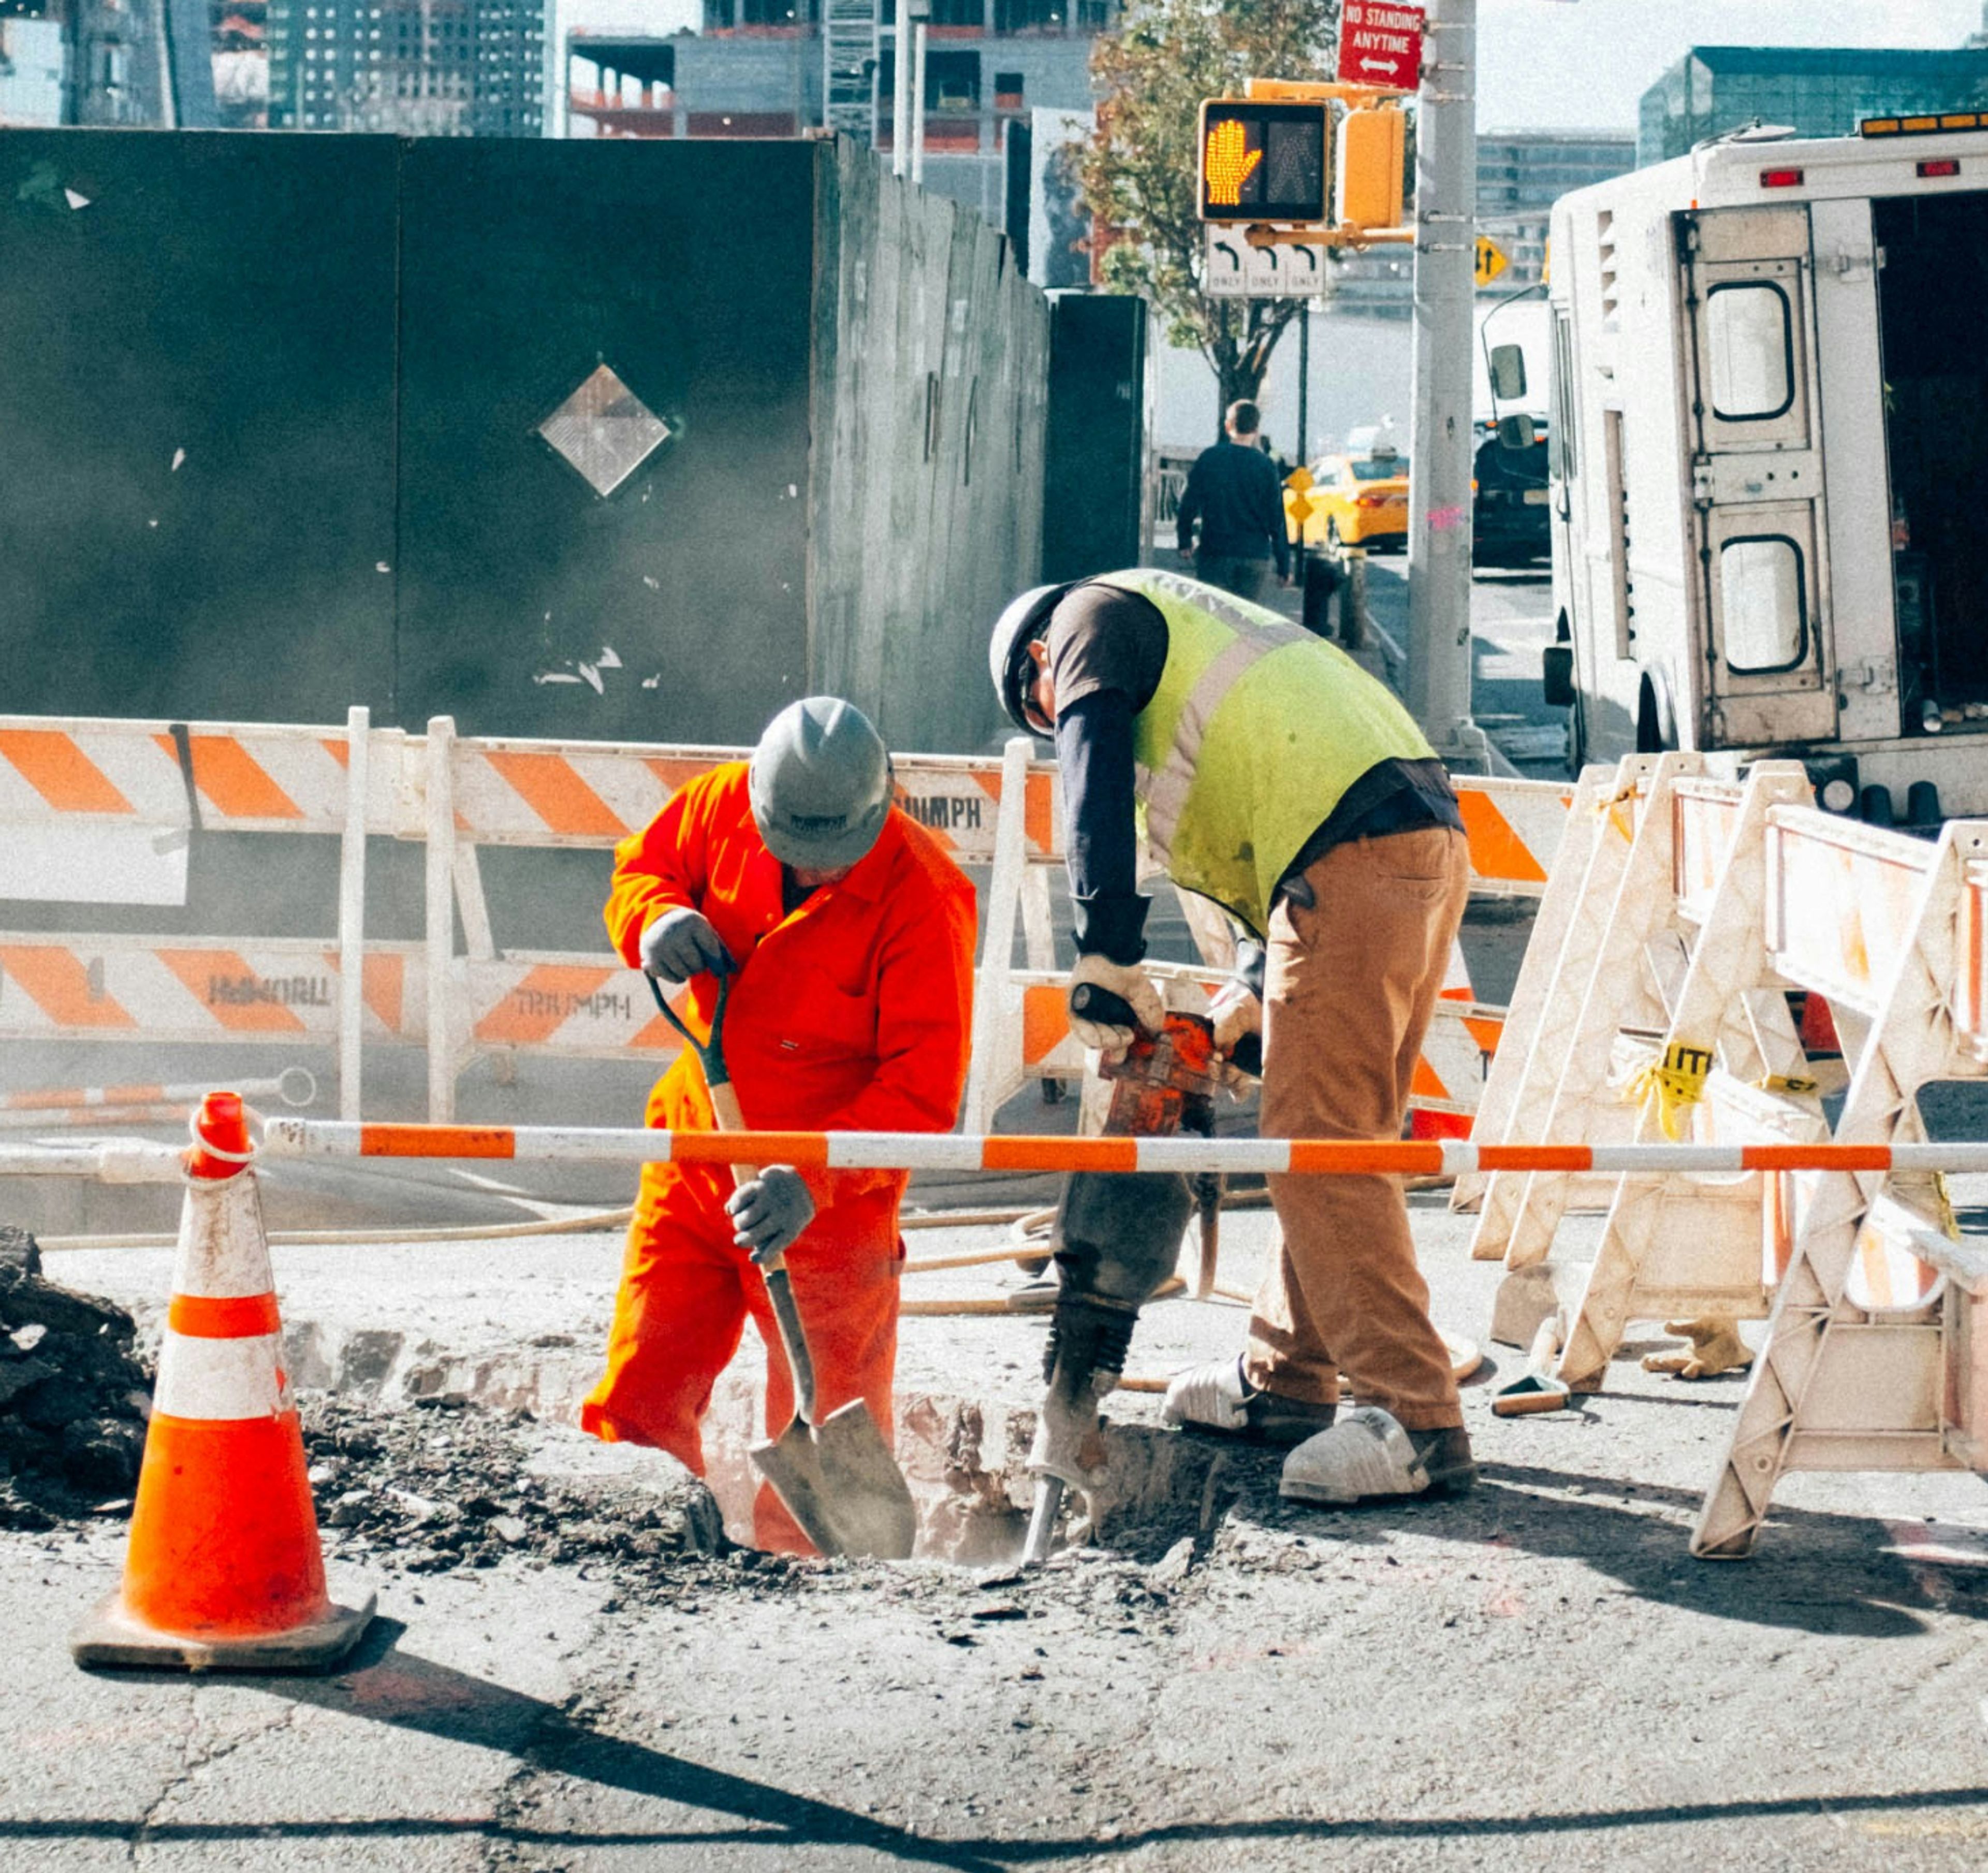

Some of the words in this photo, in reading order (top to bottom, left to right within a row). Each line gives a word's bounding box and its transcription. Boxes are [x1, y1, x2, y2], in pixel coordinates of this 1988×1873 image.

[1346, 6, 1362, 24] NO
[1366, 9, 1421, 32] STANDING
[1353, 31, 1411, 54] ANYTIME
[1214, 277, 1239, 286] ONLY
[1252, 277, 1279, 286] ONLY
[1292, 277, 1319, 286] ONLY
[516, 989, 631, 1019] TRIUMPH
